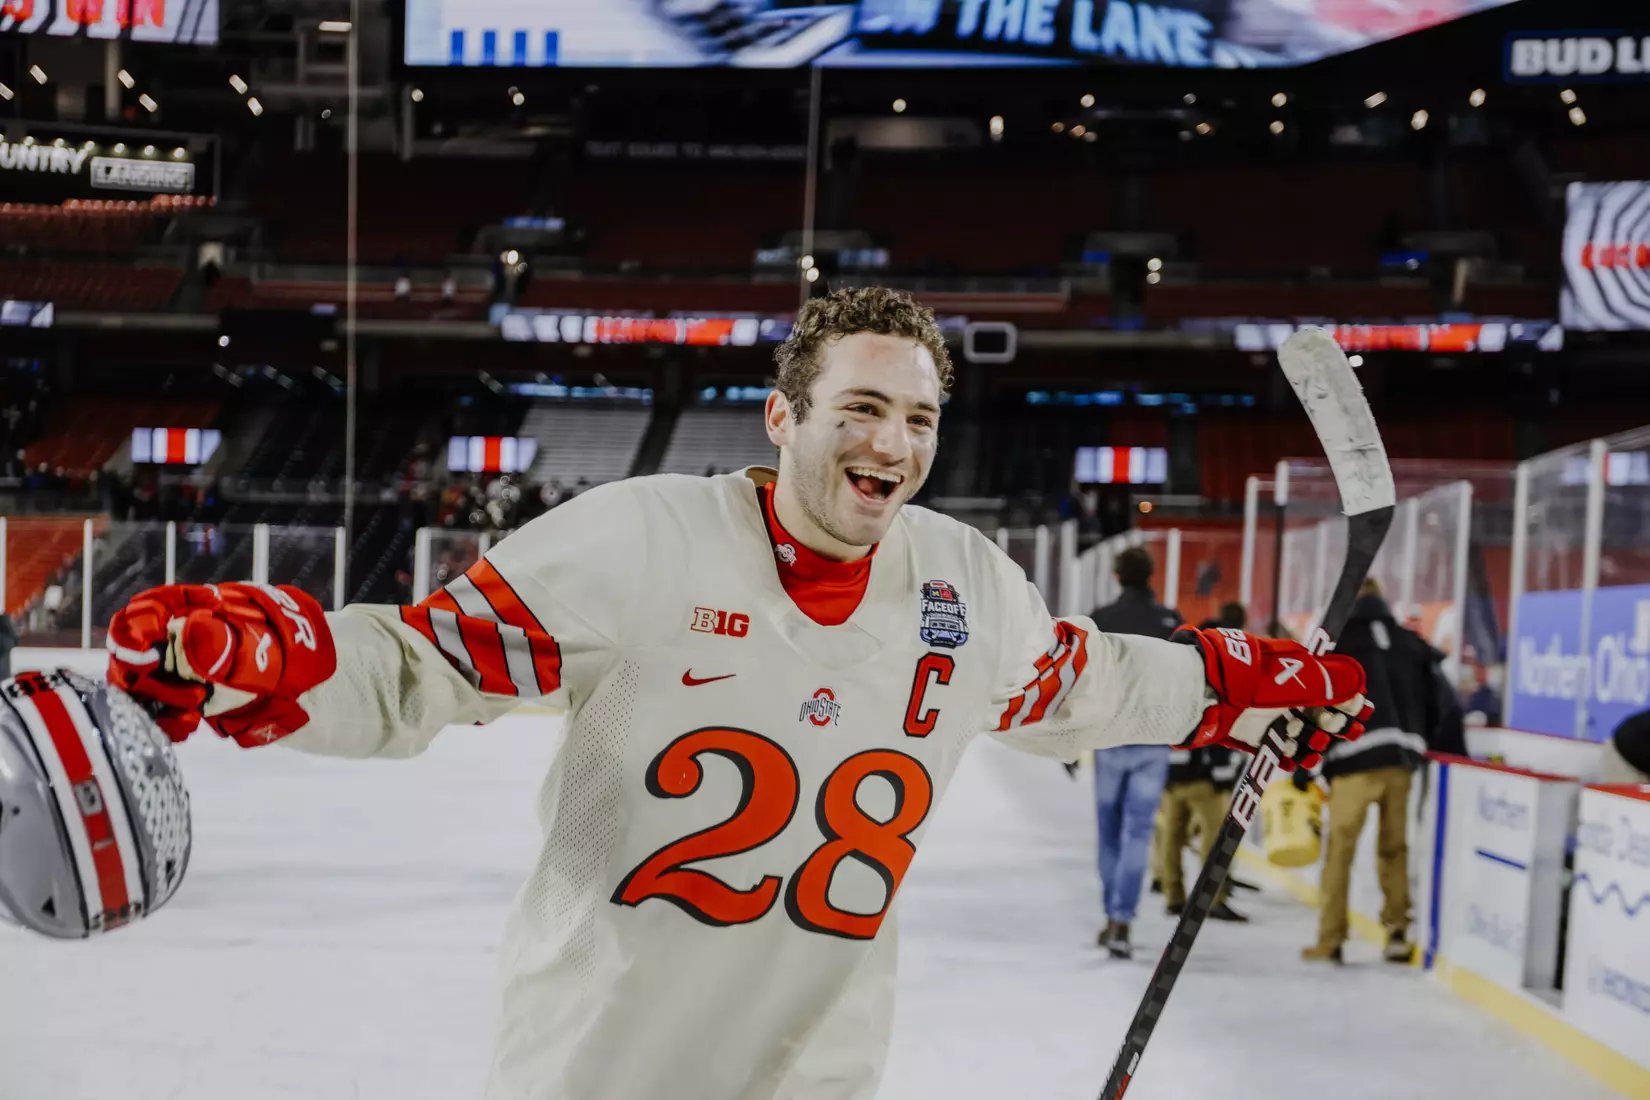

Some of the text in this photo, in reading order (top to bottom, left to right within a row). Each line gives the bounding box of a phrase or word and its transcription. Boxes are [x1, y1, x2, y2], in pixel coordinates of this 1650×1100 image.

[955, 0, 1056, 45] THE
[1072, 0, 1213, 66] LAKE
[1511, 37, 1613, 76] BUD
[921, 599, 967, 617] FACEOFF
[903, 651, 955, 738] C
[610, 726, 934, 940] 28
